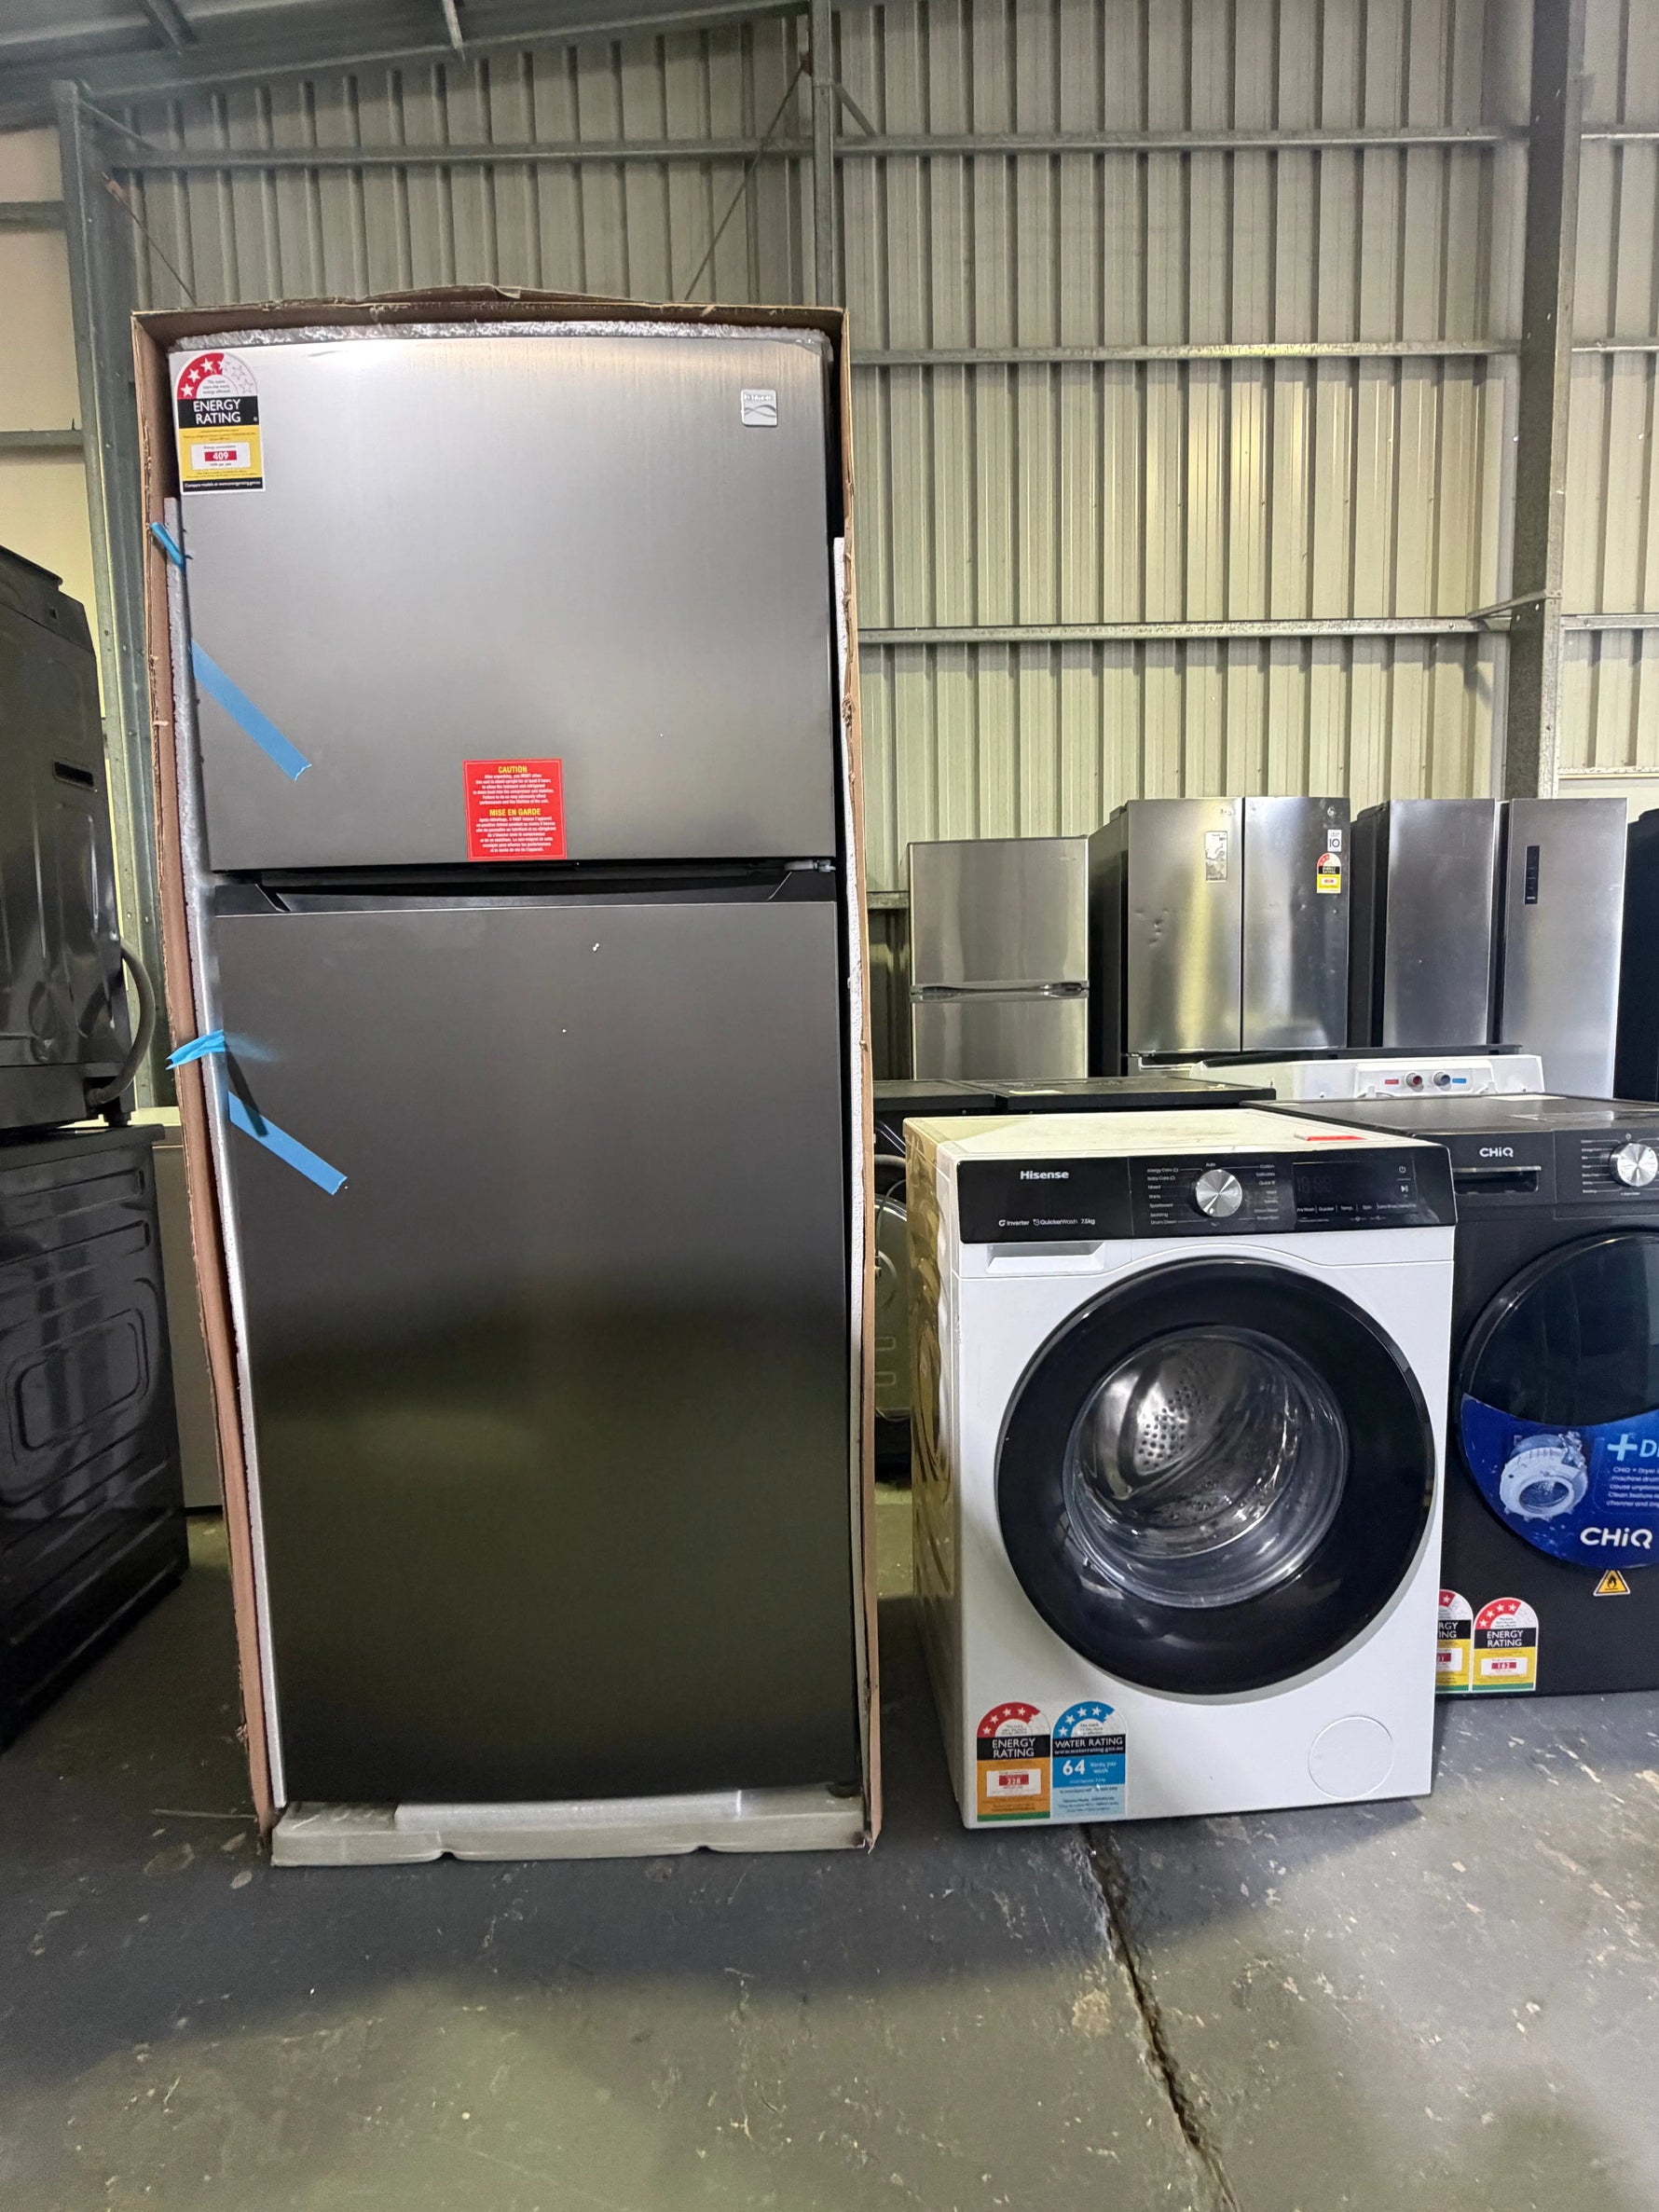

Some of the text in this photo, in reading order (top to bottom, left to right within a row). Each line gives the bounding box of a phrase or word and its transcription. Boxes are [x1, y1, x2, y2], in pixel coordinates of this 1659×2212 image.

[193, 398, 241, 412] ENERGY
[195, 411, 241, 425] RATING
[213, 452, 229, 460] 409
[498, 765, 528, 774] CAUTION
[489, 808, 506, 817] MISE
[1479, 1147, 1515, 1158] CHiQ
[1020, 1170, 1069, 1180] Hisense
[1580, 1527, 1653, 1549] CHiQ
[1438, 1622, 1459, 1630] RGY
[1438, 1630, 1458, 1639] ING
[1487, 1629, 1524, 1640] ENERGY
[1487, 1639, 1523, 1648] RATING
[992, 1738, 1036, 1749] ENERGY
[1054, 1737, 1123, 1749] WATER RATING
[993, 1748, 1035, 1759] RATING
[1063, 1758, 1086, 1776] 64
